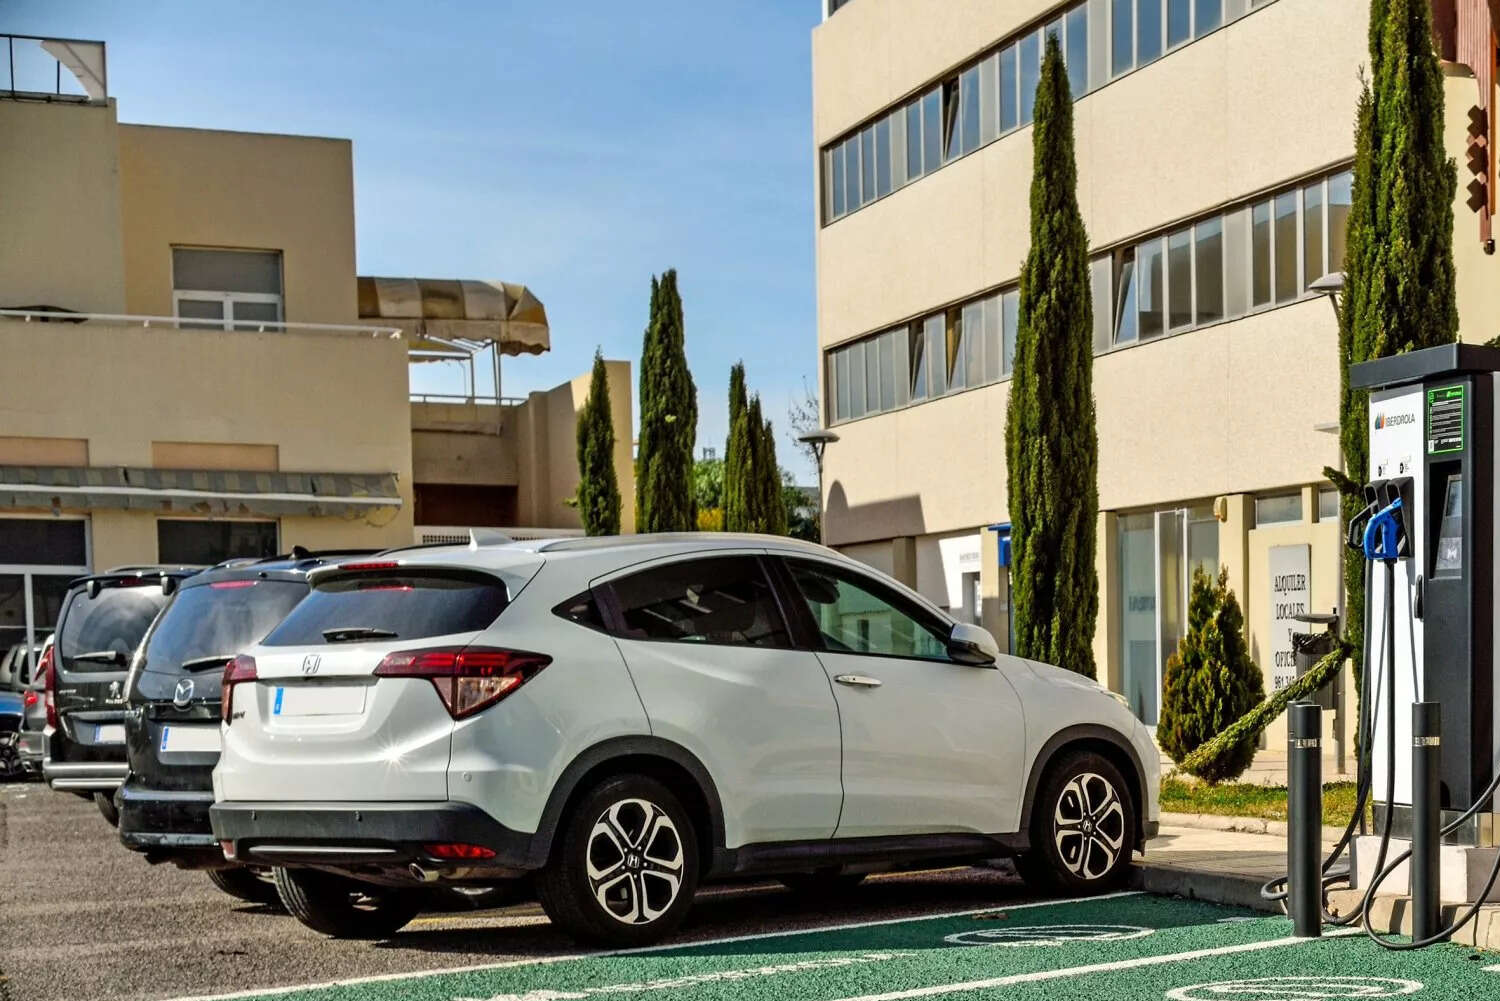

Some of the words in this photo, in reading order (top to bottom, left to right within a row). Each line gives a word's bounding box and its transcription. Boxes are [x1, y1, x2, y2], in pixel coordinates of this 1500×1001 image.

[1274, 574, 1306, 595] ALQUILER
[1276, 602, 1305, 620] LOCALES
[1288, 628, 1294, 642] Y
